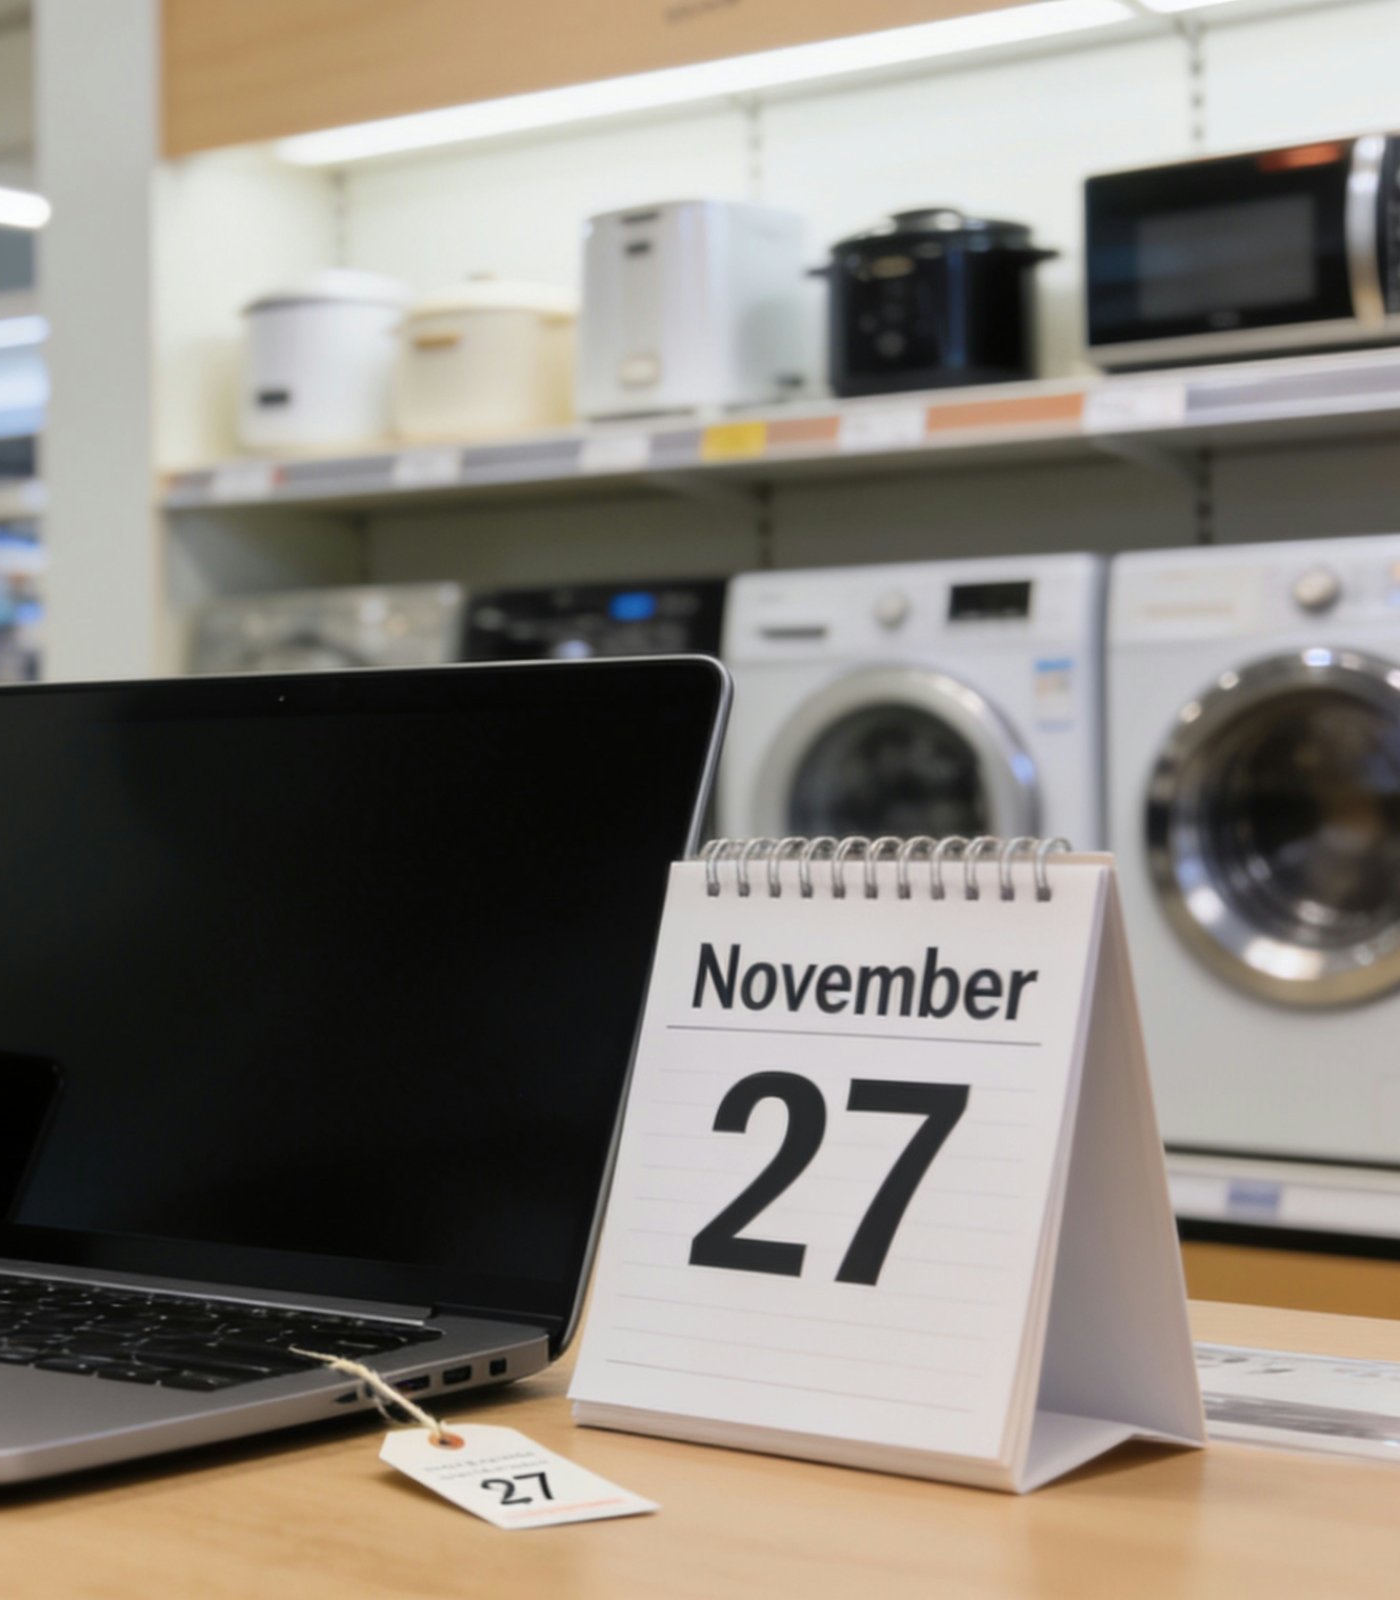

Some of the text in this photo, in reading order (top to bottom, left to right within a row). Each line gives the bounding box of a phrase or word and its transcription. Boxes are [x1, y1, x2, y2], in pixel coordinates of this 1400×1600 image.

[692, 942, 1039, 1021] November
[688, 1069, 972, 1287] 27
[481, 1472, 554, 1505] 27
